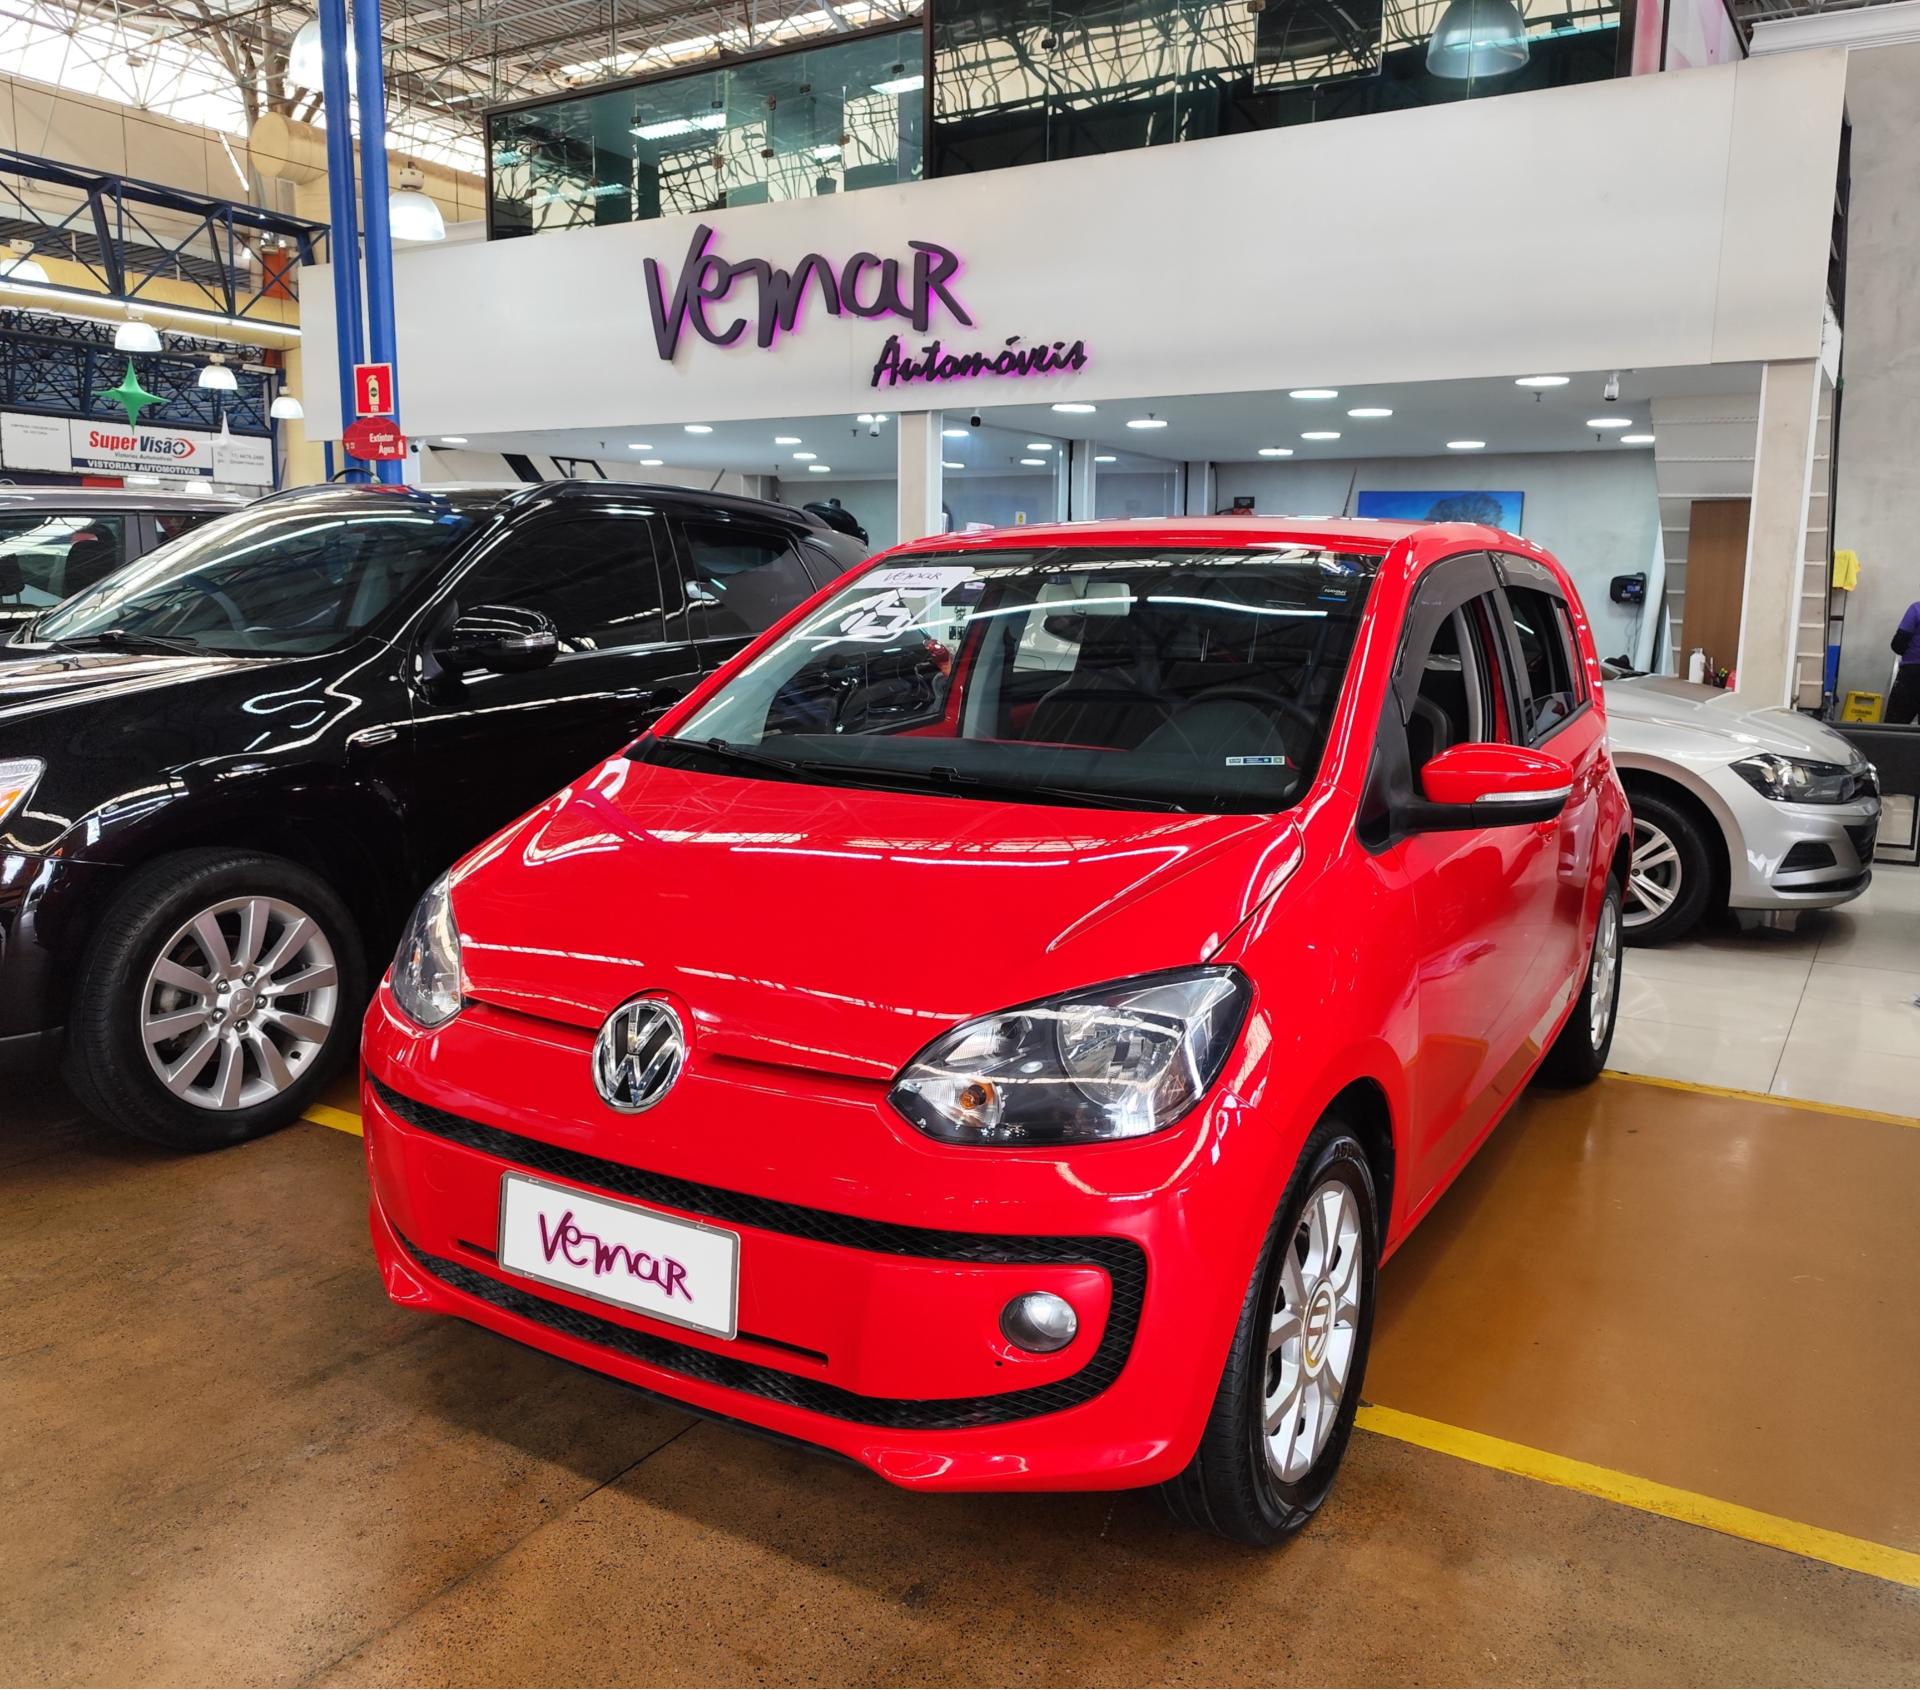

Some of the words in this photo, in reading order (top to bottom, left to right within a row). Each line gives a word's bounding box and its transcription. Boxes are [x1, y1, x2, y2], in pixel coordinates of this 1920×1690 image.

[871, 335, 1088, 387] Automóveis
[89, 431, 137, 451] Super
[140, 435, 186, 455] Visão
[369, 433, 394, 443] Extintor
[378, 443, 395, 455] Água
[87, 460, 137, 471] VISTORIAS
[138, 464, 200, 475] AUTOMOTIVAS
